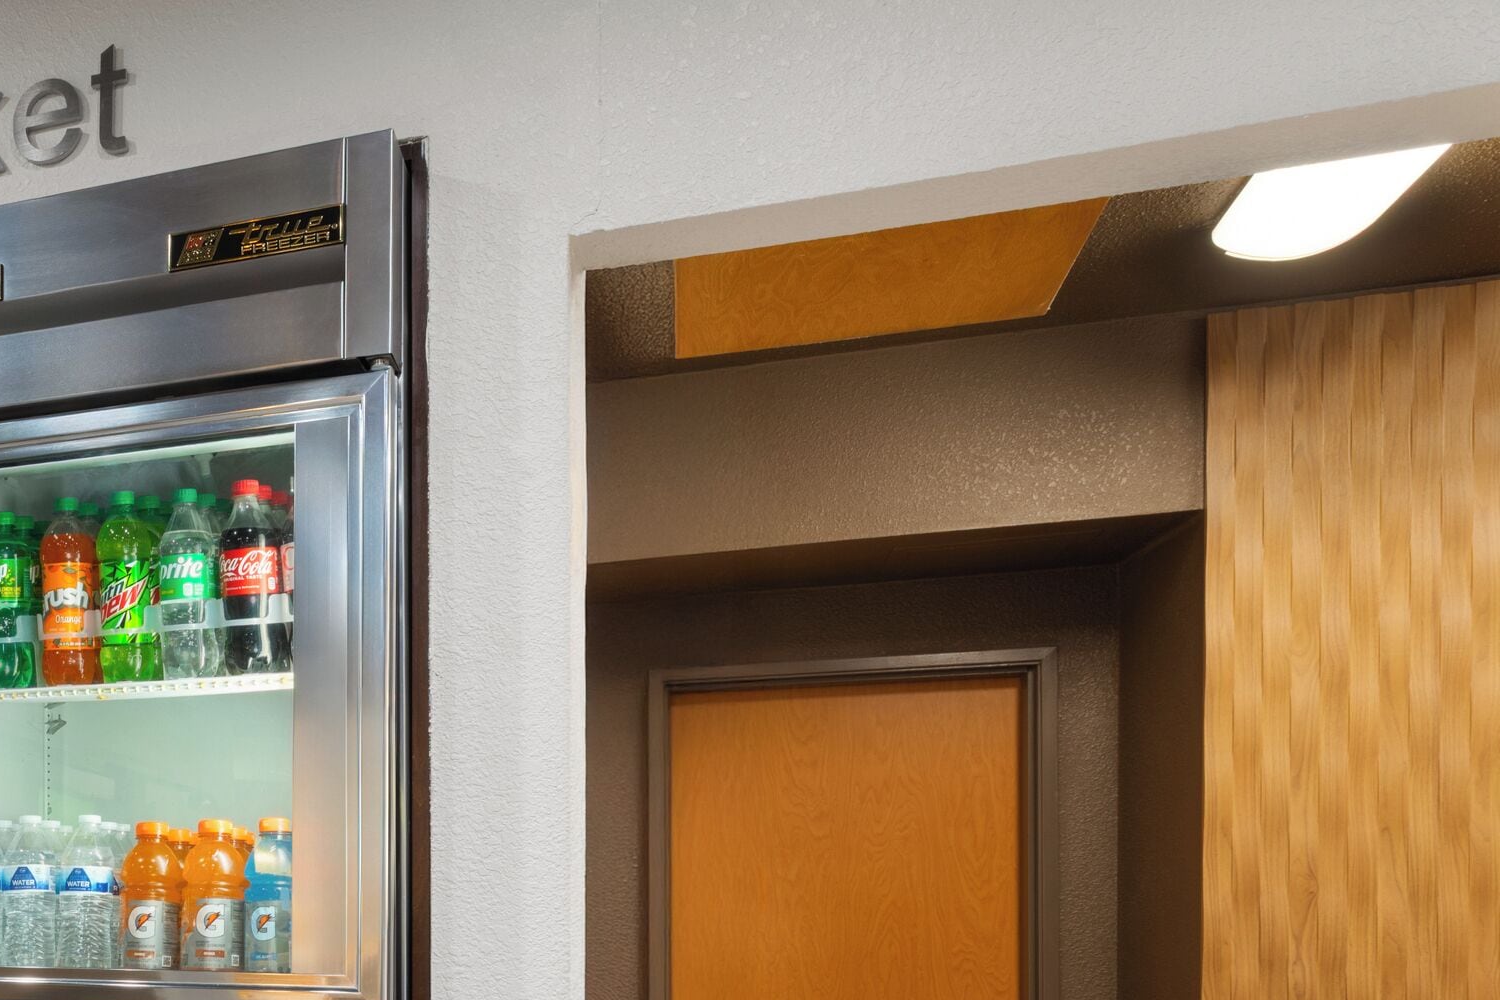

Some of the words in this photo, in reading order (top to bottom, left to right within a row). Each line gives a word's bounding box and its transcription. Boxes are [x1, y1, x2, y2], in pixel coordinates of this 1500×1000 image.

[241, 231, 330, 256] FREEZER
[161, 556, 203, 579] prite
[43, 582, 88, 612] rush
[55, 614, 81, 624] Orange
